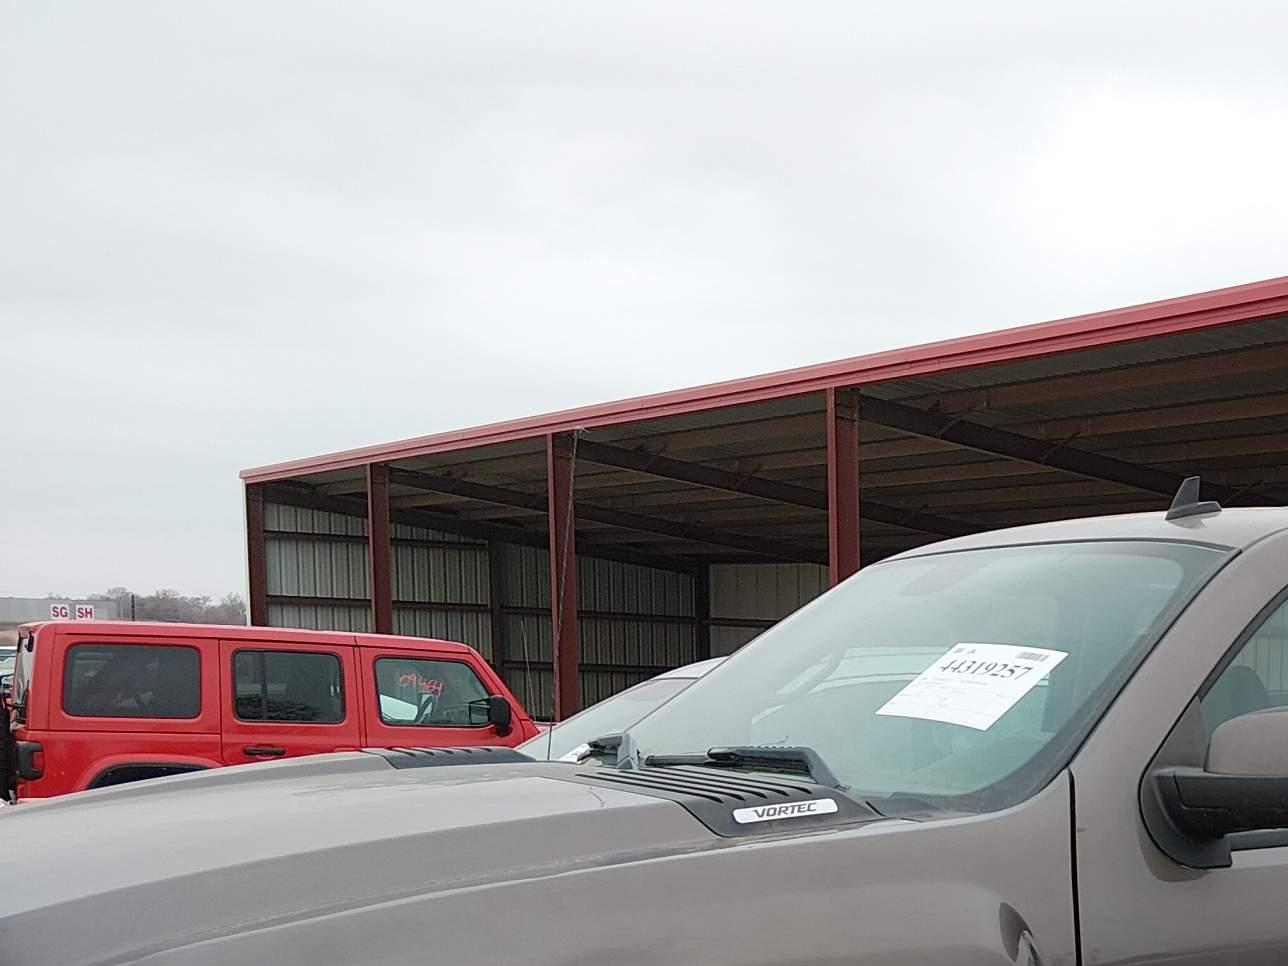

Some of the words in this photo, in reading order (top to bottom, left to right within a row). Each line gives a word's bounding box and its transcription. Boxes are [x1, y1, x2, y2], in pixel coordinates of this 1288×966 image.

[52, 606, 68, 618] SG
[77, 607, 93, 619] SH
[940, 659, 1034, 680] 44319257
[753, 802, 818, 818] VORTEC
